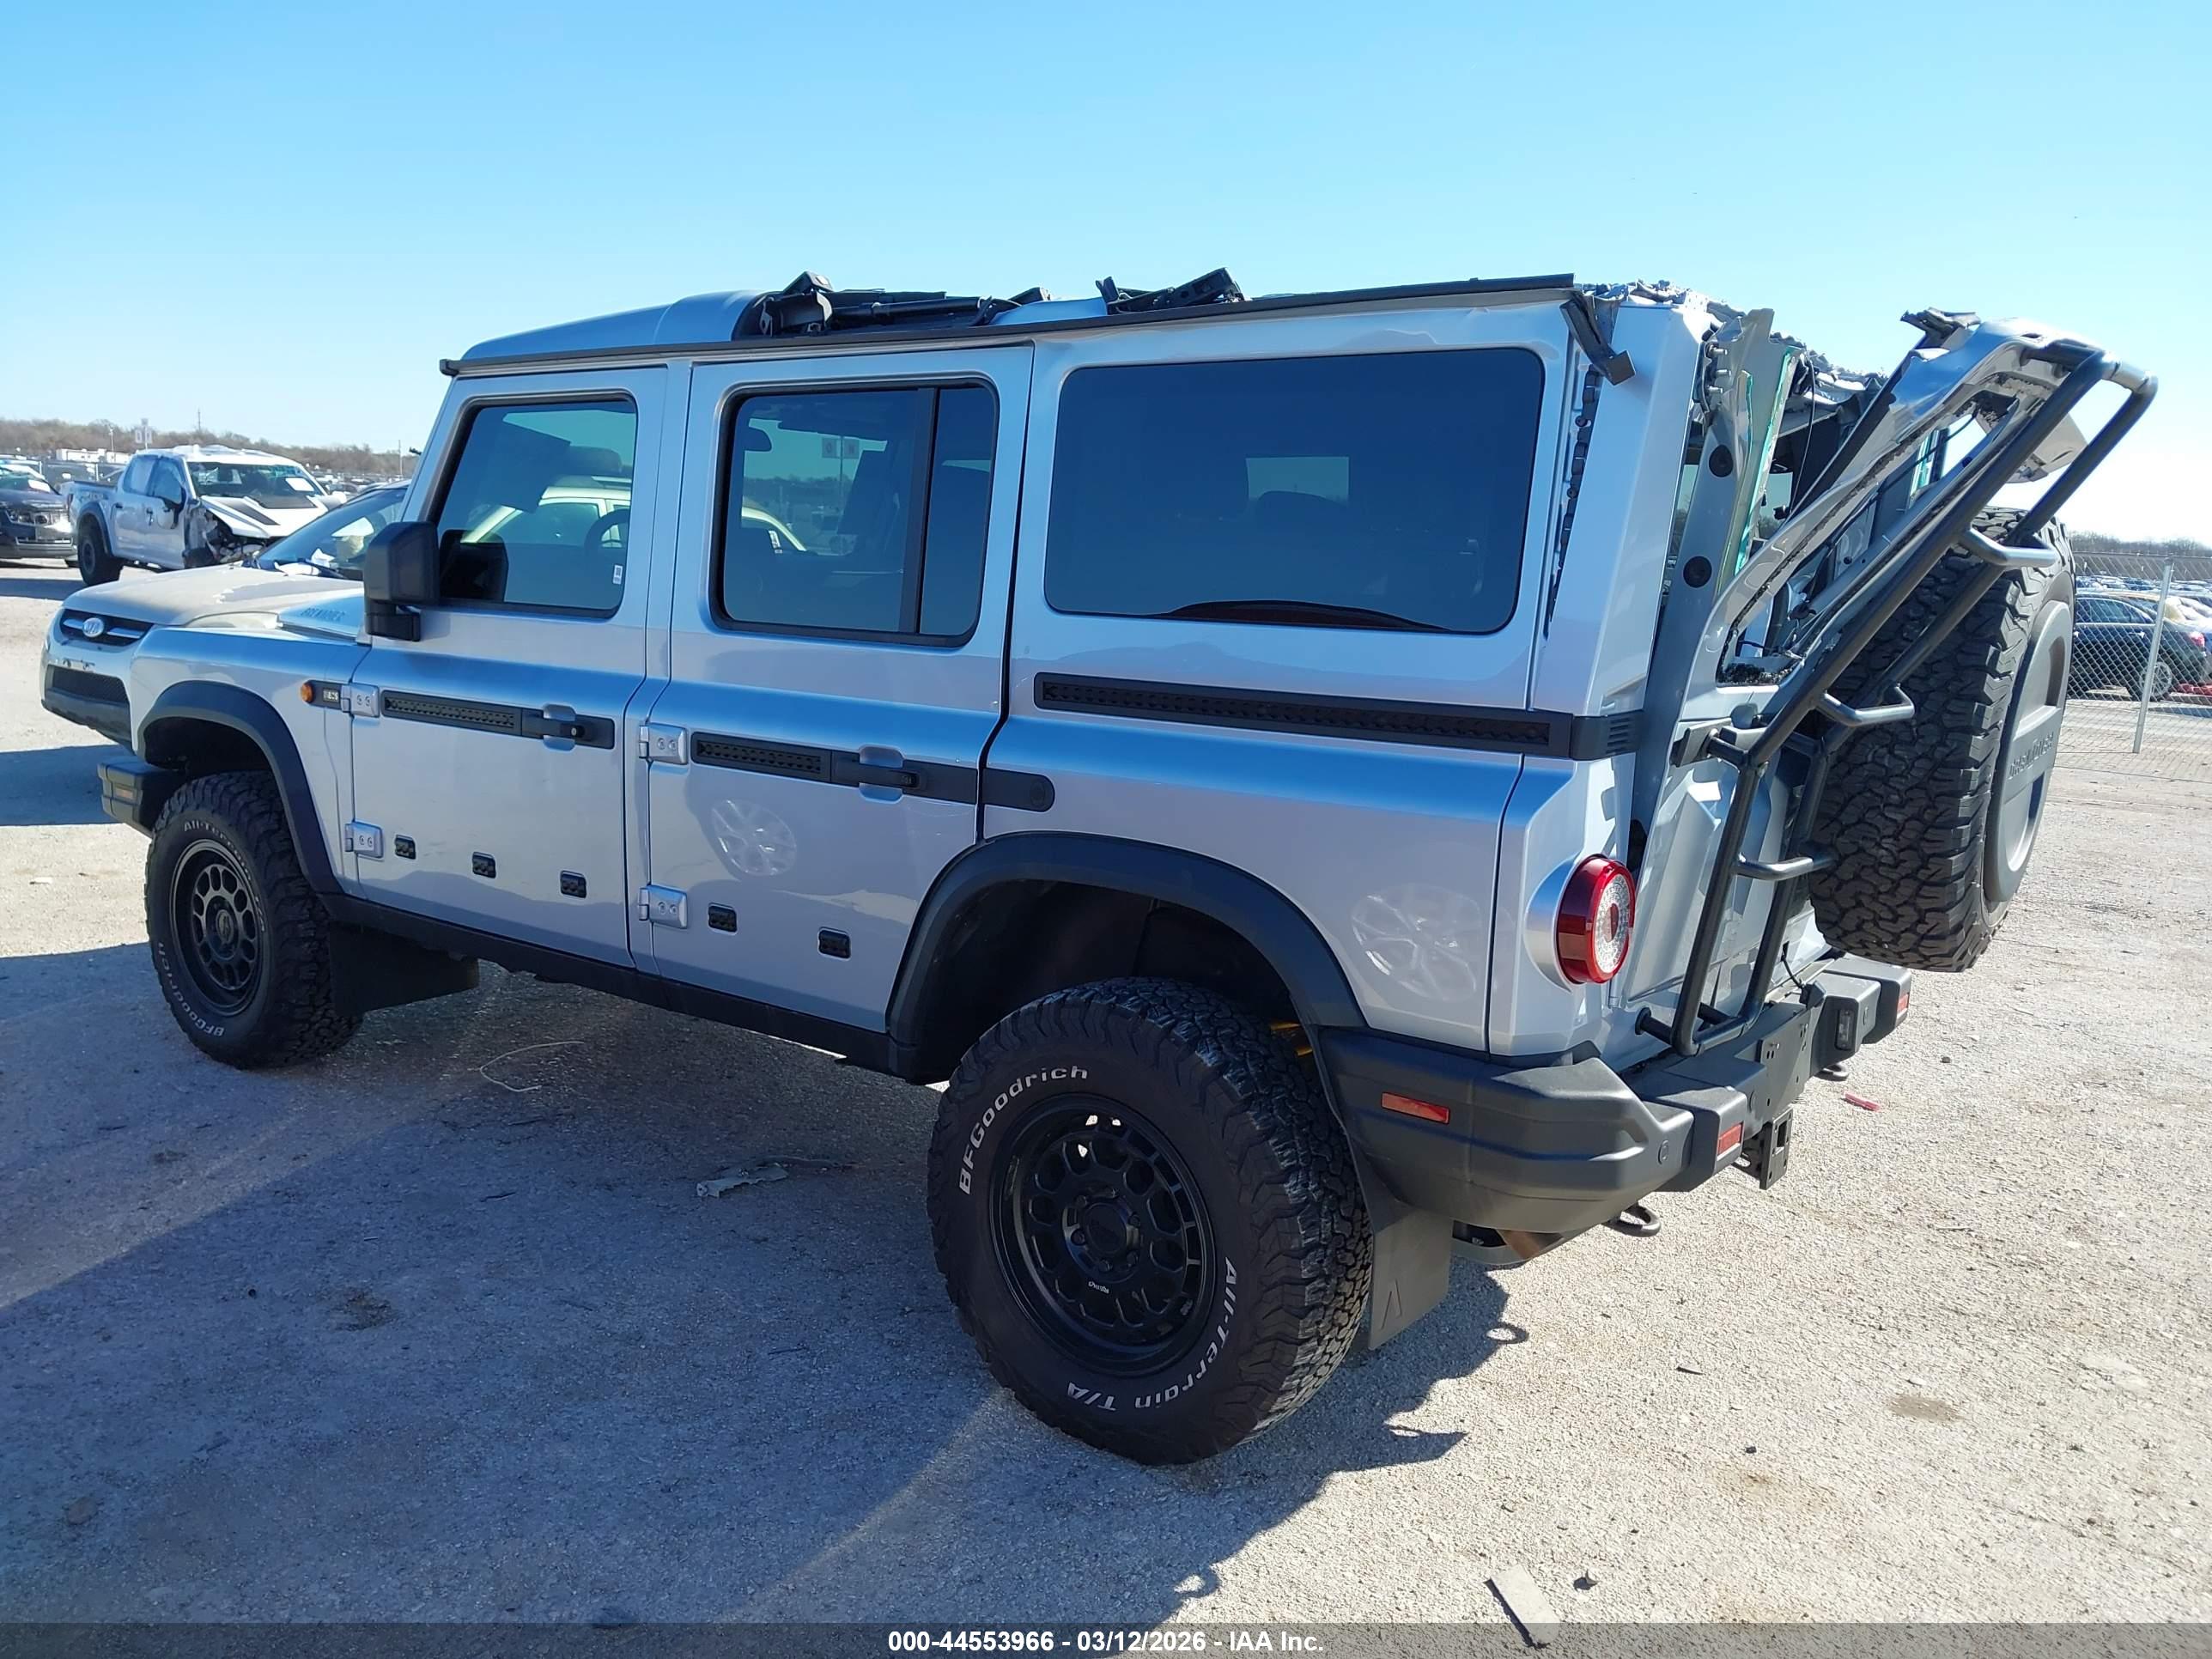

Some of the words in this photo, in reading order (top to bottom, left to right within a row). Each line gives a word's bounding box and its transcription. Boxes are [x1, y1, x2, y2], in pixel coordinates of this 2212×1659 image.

[958, 1065, 1089, 1195] BFGoodrich
[1066, 1382, 1118, 1412] T/A
[1134, 1256, 1237, 1409] All-Terrain
